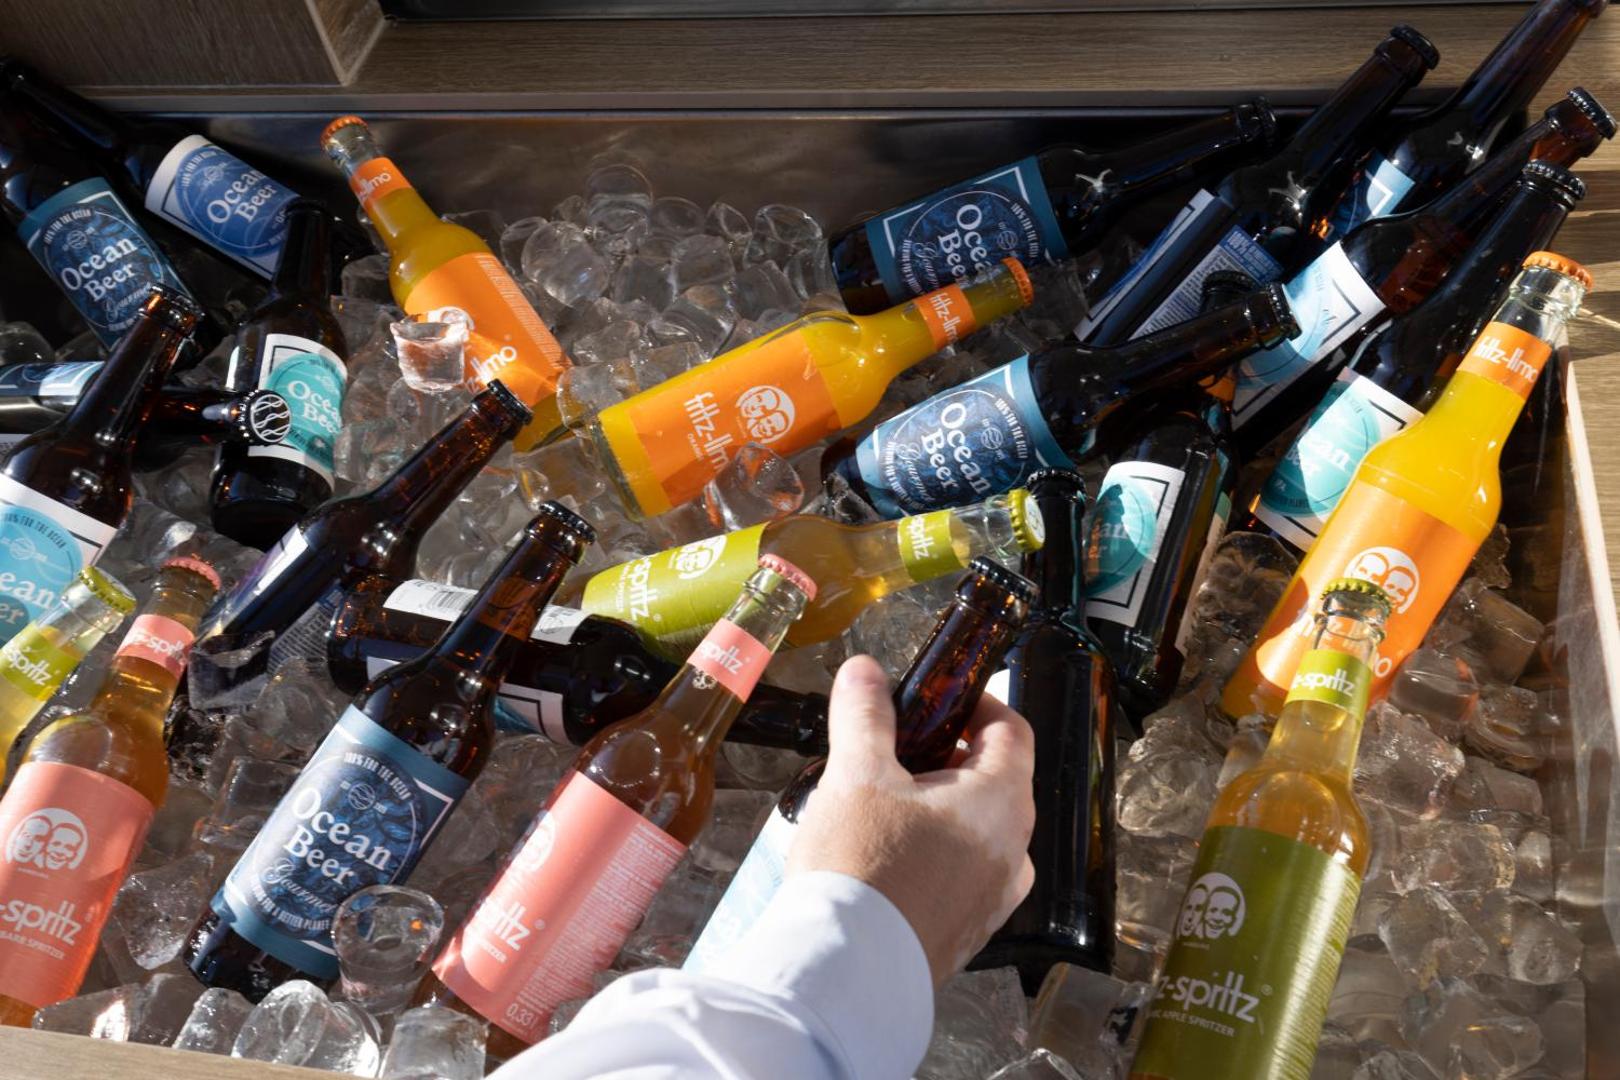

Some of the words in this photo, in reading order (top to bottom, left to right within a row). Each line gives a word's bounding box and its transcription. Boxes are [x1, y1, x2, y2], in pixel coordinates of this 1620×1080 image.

[207, 170, 266, 223] Ocean
[234, 184, 277, 222] Beer
[61, 238, 138, 290] Ocean
[84, 263, 136, 301] Beer
[921, 428, 960, 490] Beer
[941, 402, 992, 495] Ocean
[284, 823, 355, 886] Beer
[291, 786, 394, 871] Ocean
[1188, 1014, 1236, 1037] SPRITZER
